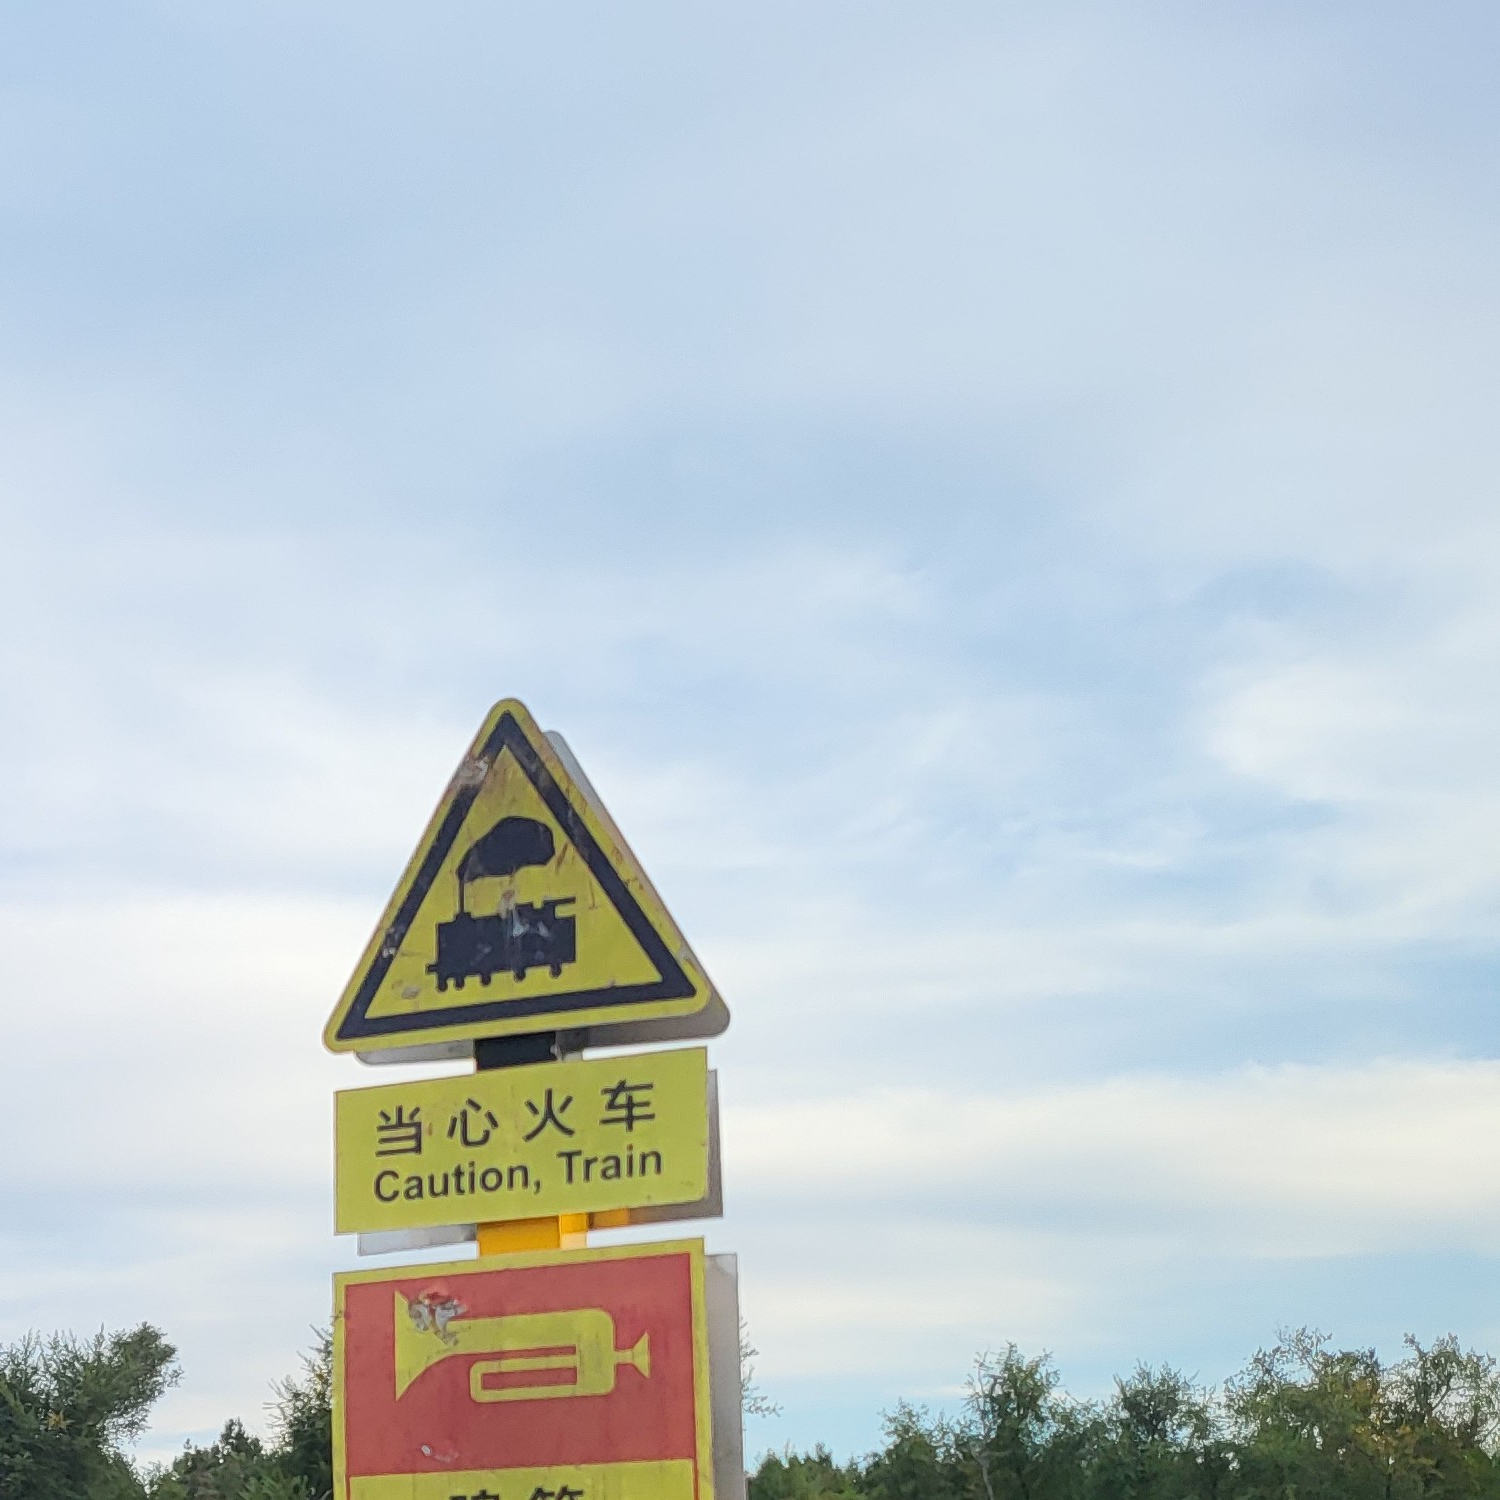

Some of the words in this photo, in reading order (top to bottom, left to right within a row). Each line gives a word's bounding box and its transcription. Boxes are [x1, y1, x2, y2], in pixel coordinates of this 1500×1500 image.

[374, 1079, 656, 1158] 当心火车
[373, 1161, 542, 1203] Caution,
[556, 1144, 663, 1185] Train
